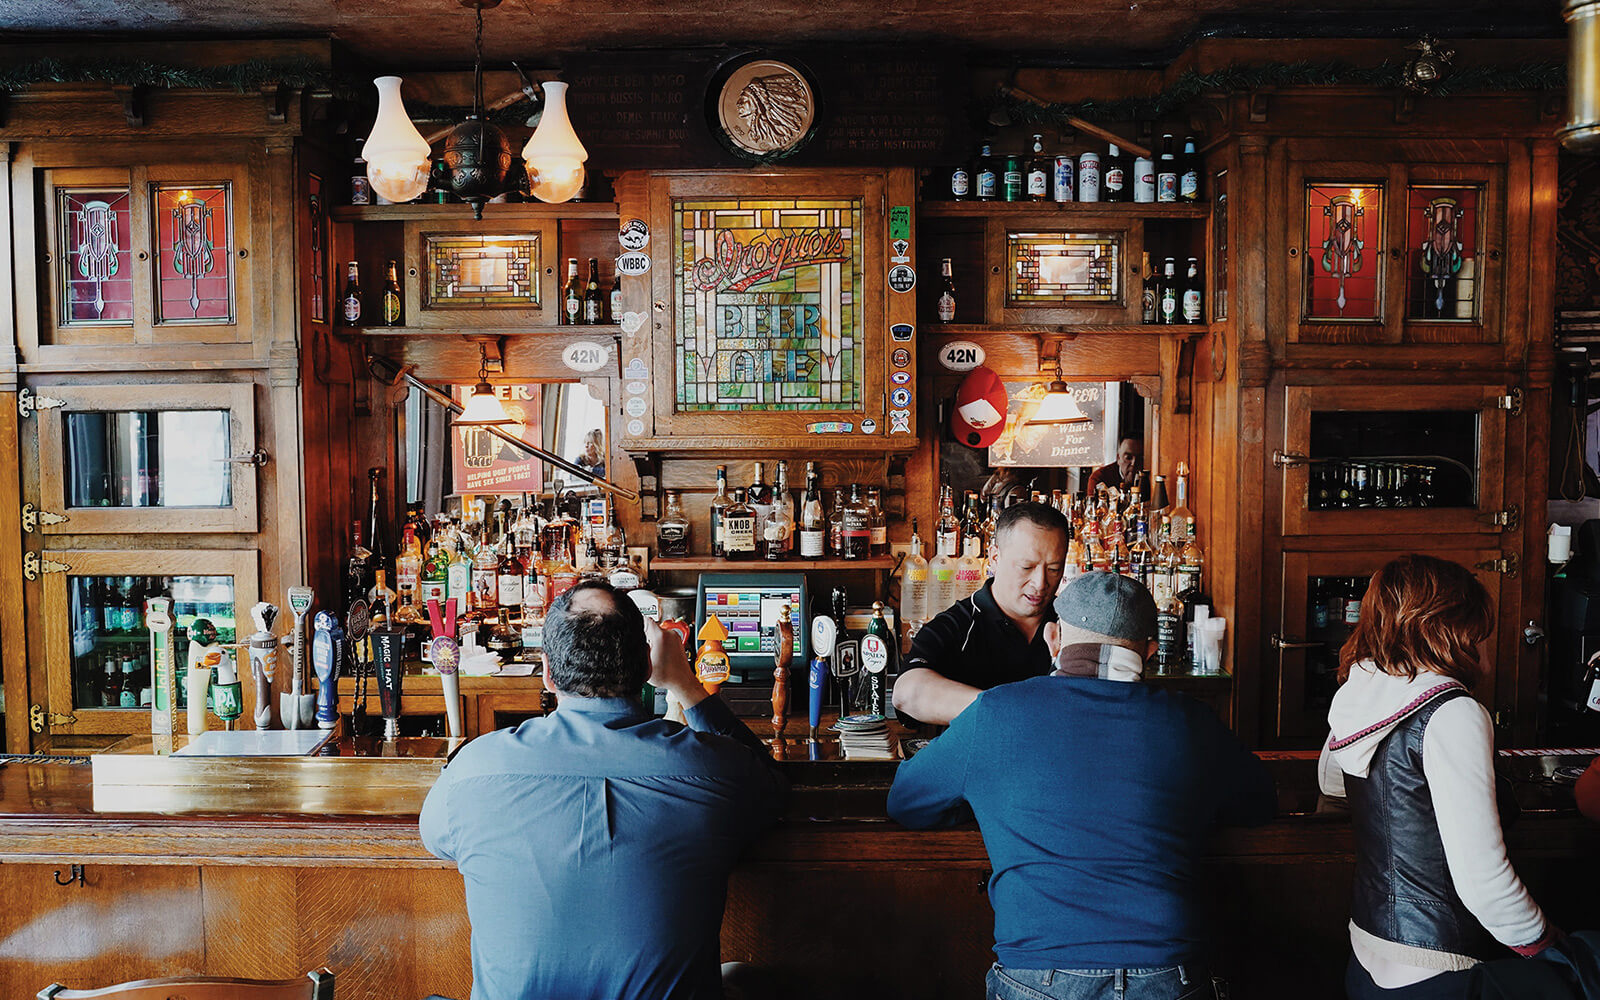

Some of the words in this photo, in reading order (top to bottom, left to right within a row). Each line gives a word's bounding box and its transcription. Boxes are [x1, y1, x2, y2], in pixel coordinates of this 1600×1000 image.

[622, 257, 646, 270] WBBC
[716, 305, 820, 338] BEER
[570, 350, 600, 364] 42N
[946, 349, 976, 363] 42N
[730, 350, 810, 383] ALE
[1065, 434, 1084, 445] For
[1050, 446, 1091, 457] Dinner
[467, 471, 491, 481] HELPING
[492, 467, 506, 477] UGLY
[507, 463, 530, 475] PEOPLE
[467, 480, 482, 489] HAVE
[483, 477, 494, 486] SEX
[495, 474, 512, 484] SINCE
[728, 519, 750, 530] KNOB
[167, 631, 176, 676] BREWING
[381, 636, 391, 662] MAGIC
[862, 650, 886, 659] SPATEN
[385, 669, 393, 690] HAT
[170, 703, 178, 732] CIGAR
